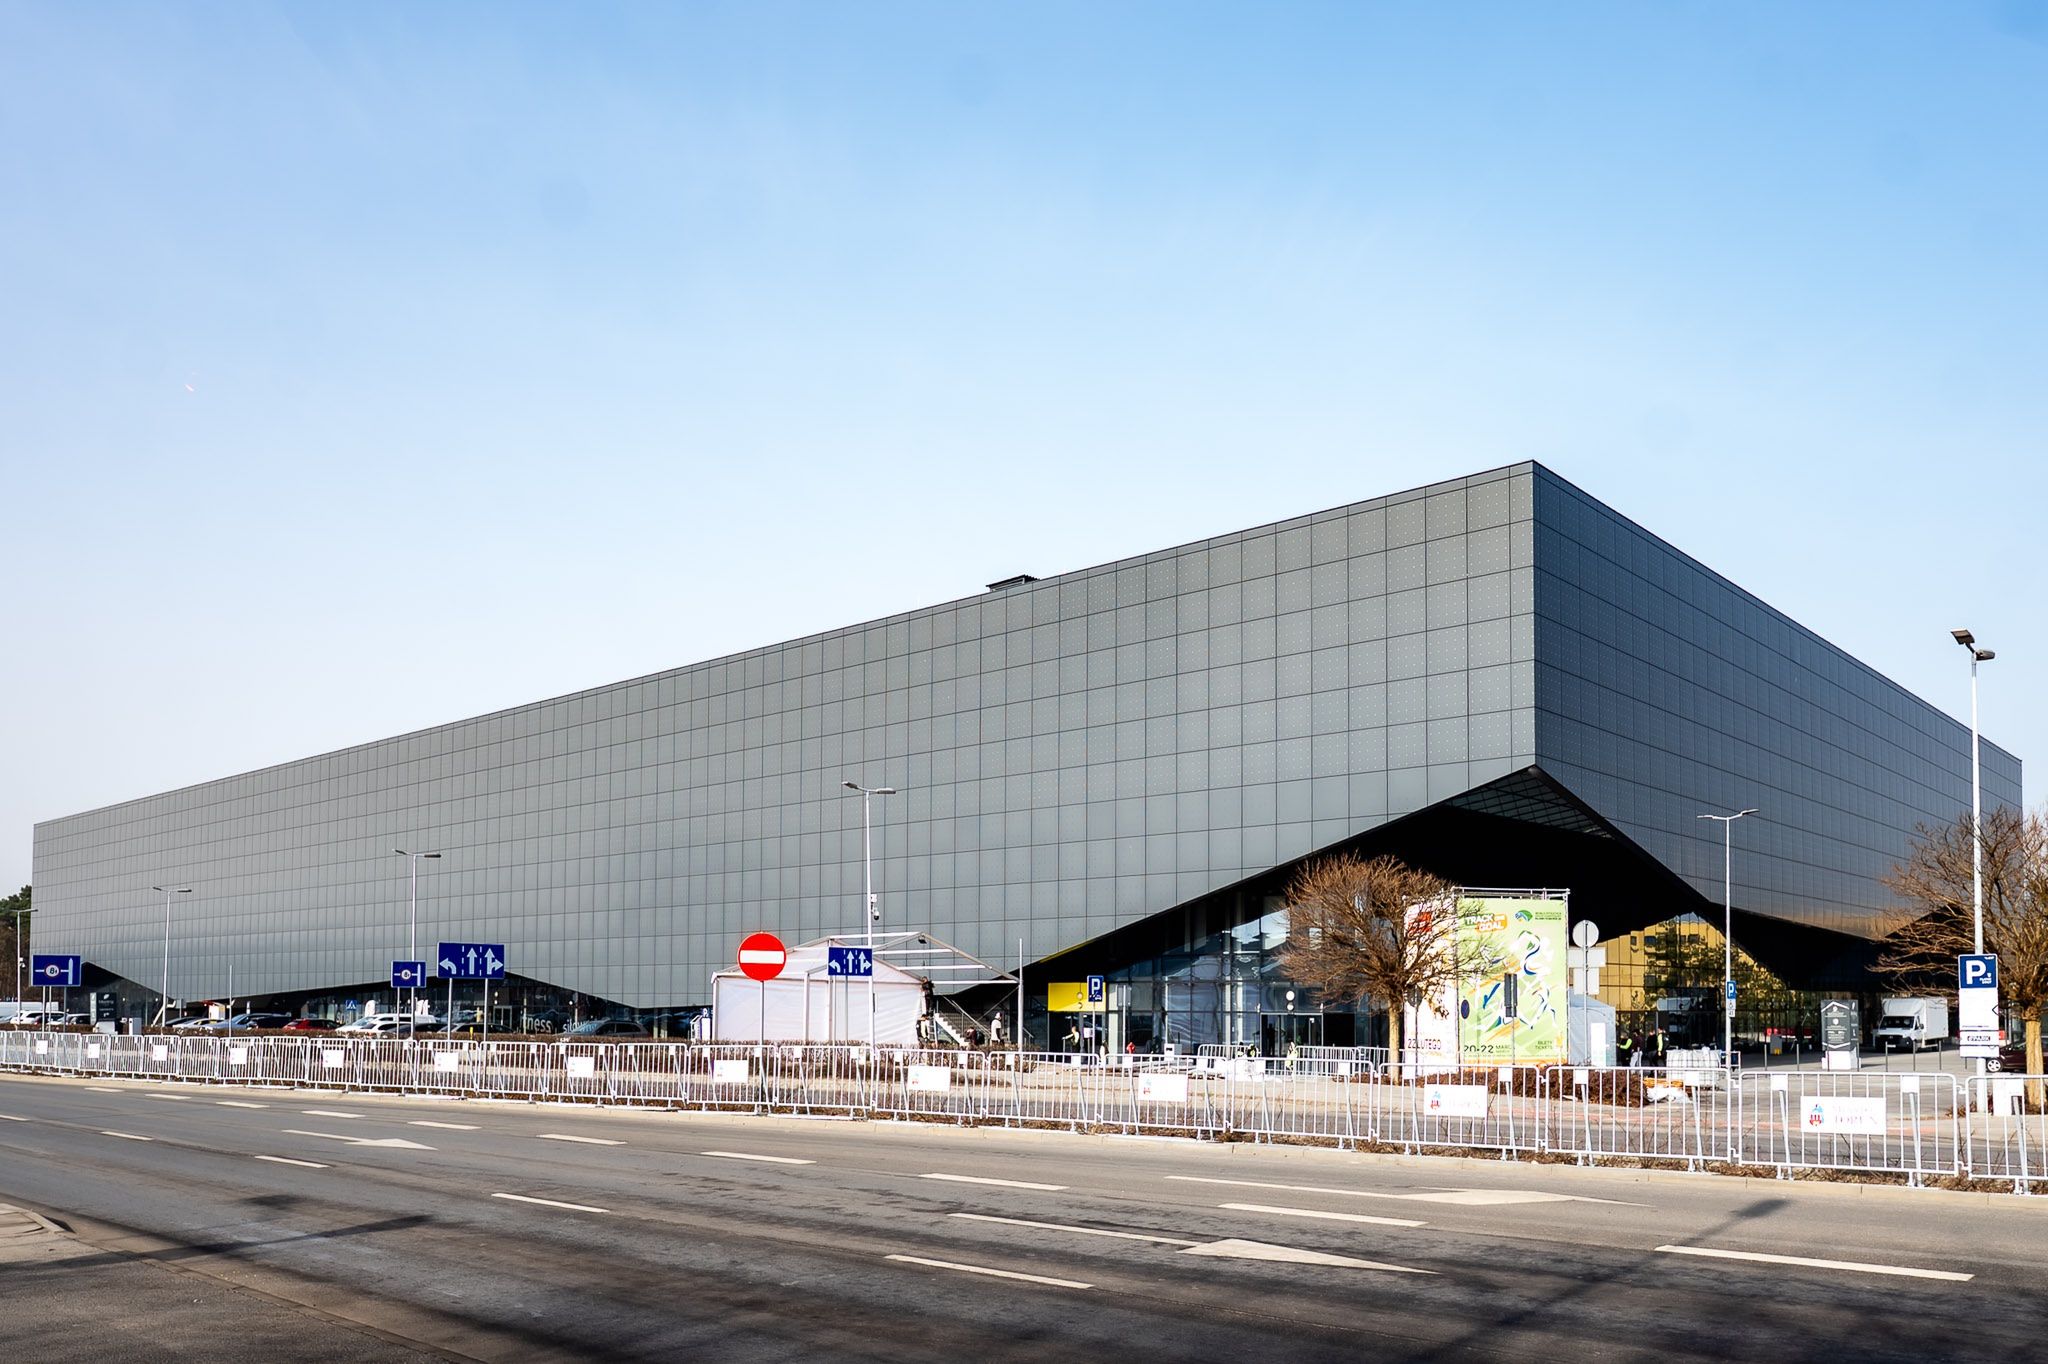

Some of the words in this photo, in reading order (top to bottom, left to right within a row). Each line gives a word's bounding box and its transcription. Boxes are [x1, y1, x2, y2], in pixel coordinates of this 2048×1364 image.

[1479, 921, 1505, 931] GOAL
[1966, 960, 1986, 985] P
[1091, 978, 1101, 995] P
[1728, 983, 1735, 998] P
